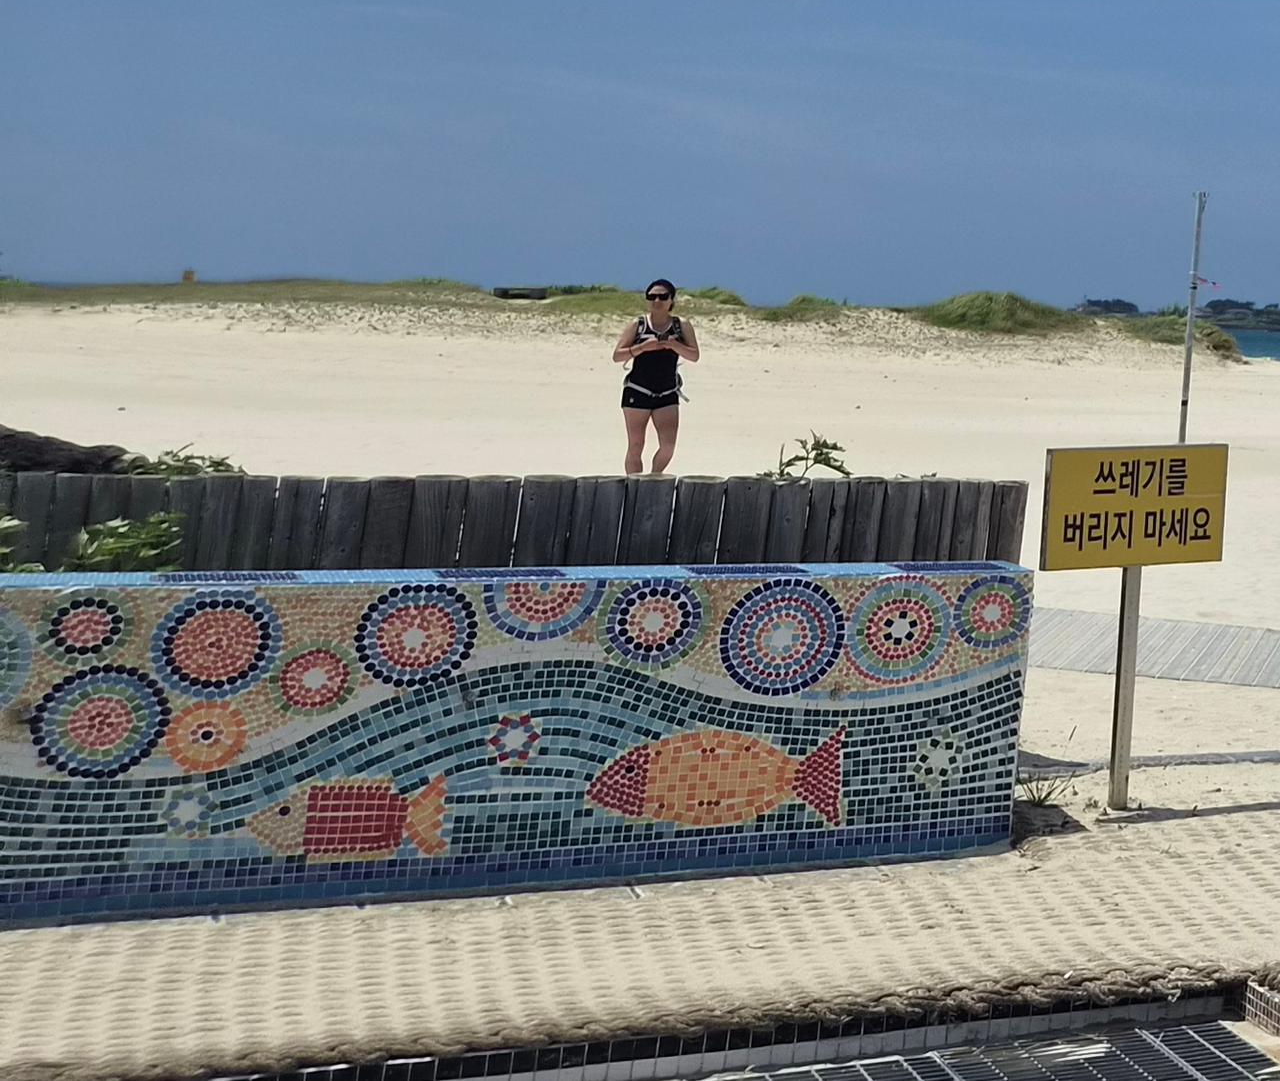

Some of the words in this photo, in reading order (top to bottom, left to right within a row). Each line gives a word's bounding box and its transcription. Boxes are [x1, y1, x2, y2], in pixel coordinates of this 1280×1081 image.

[1092, 457, 1188, 498] 쓰레기를
[1063, 509, 1134, 551] 버리지
[1143, 507, 1212, 547] 마세요
